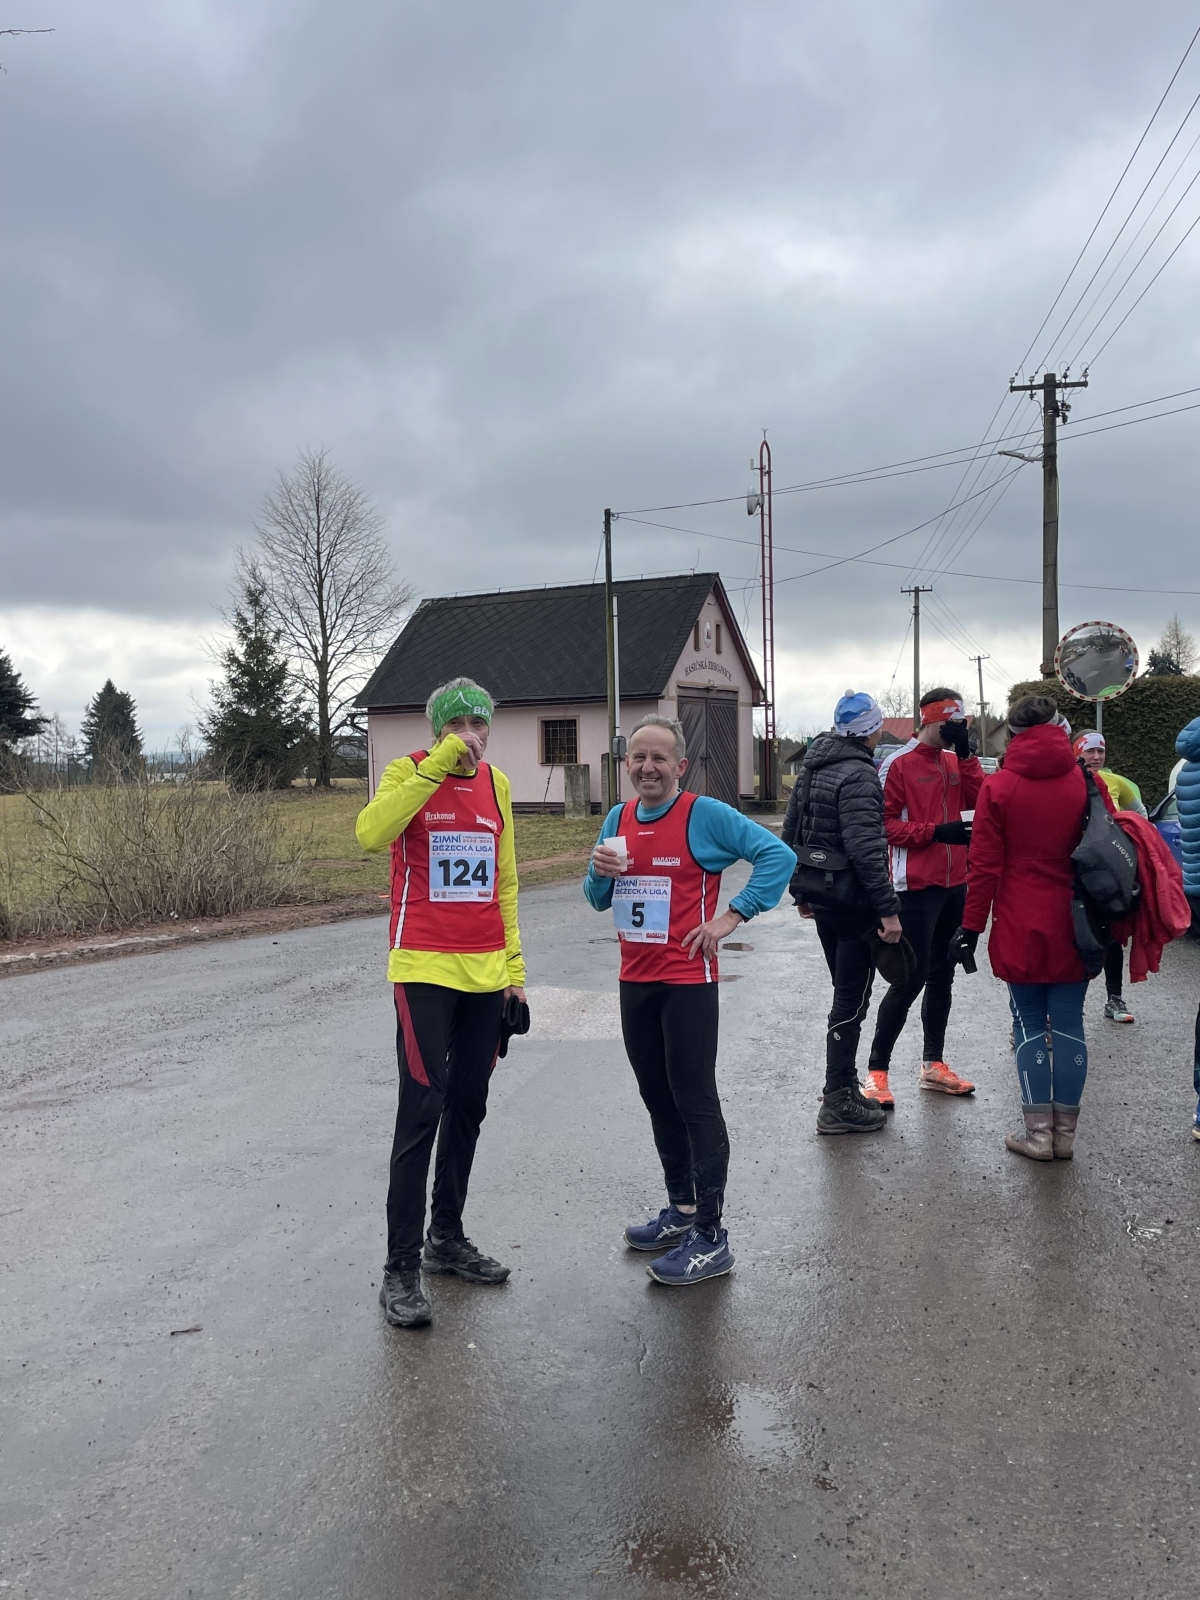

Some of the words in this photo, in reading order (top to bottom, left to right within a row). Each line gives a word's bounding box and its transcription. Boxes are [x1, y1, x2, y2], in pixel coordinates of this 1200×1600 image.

[432, 834, 461, 843] ZIMNÍ
[432, 844, 473, 852] BĚŽECKÁ
[1111, 840, 1134, 867] EVADICT
[438, 859, 489, 886] 124
[616, 879, 638, 888] ZIMNÍ
[631, 902, 645, 928] 5
